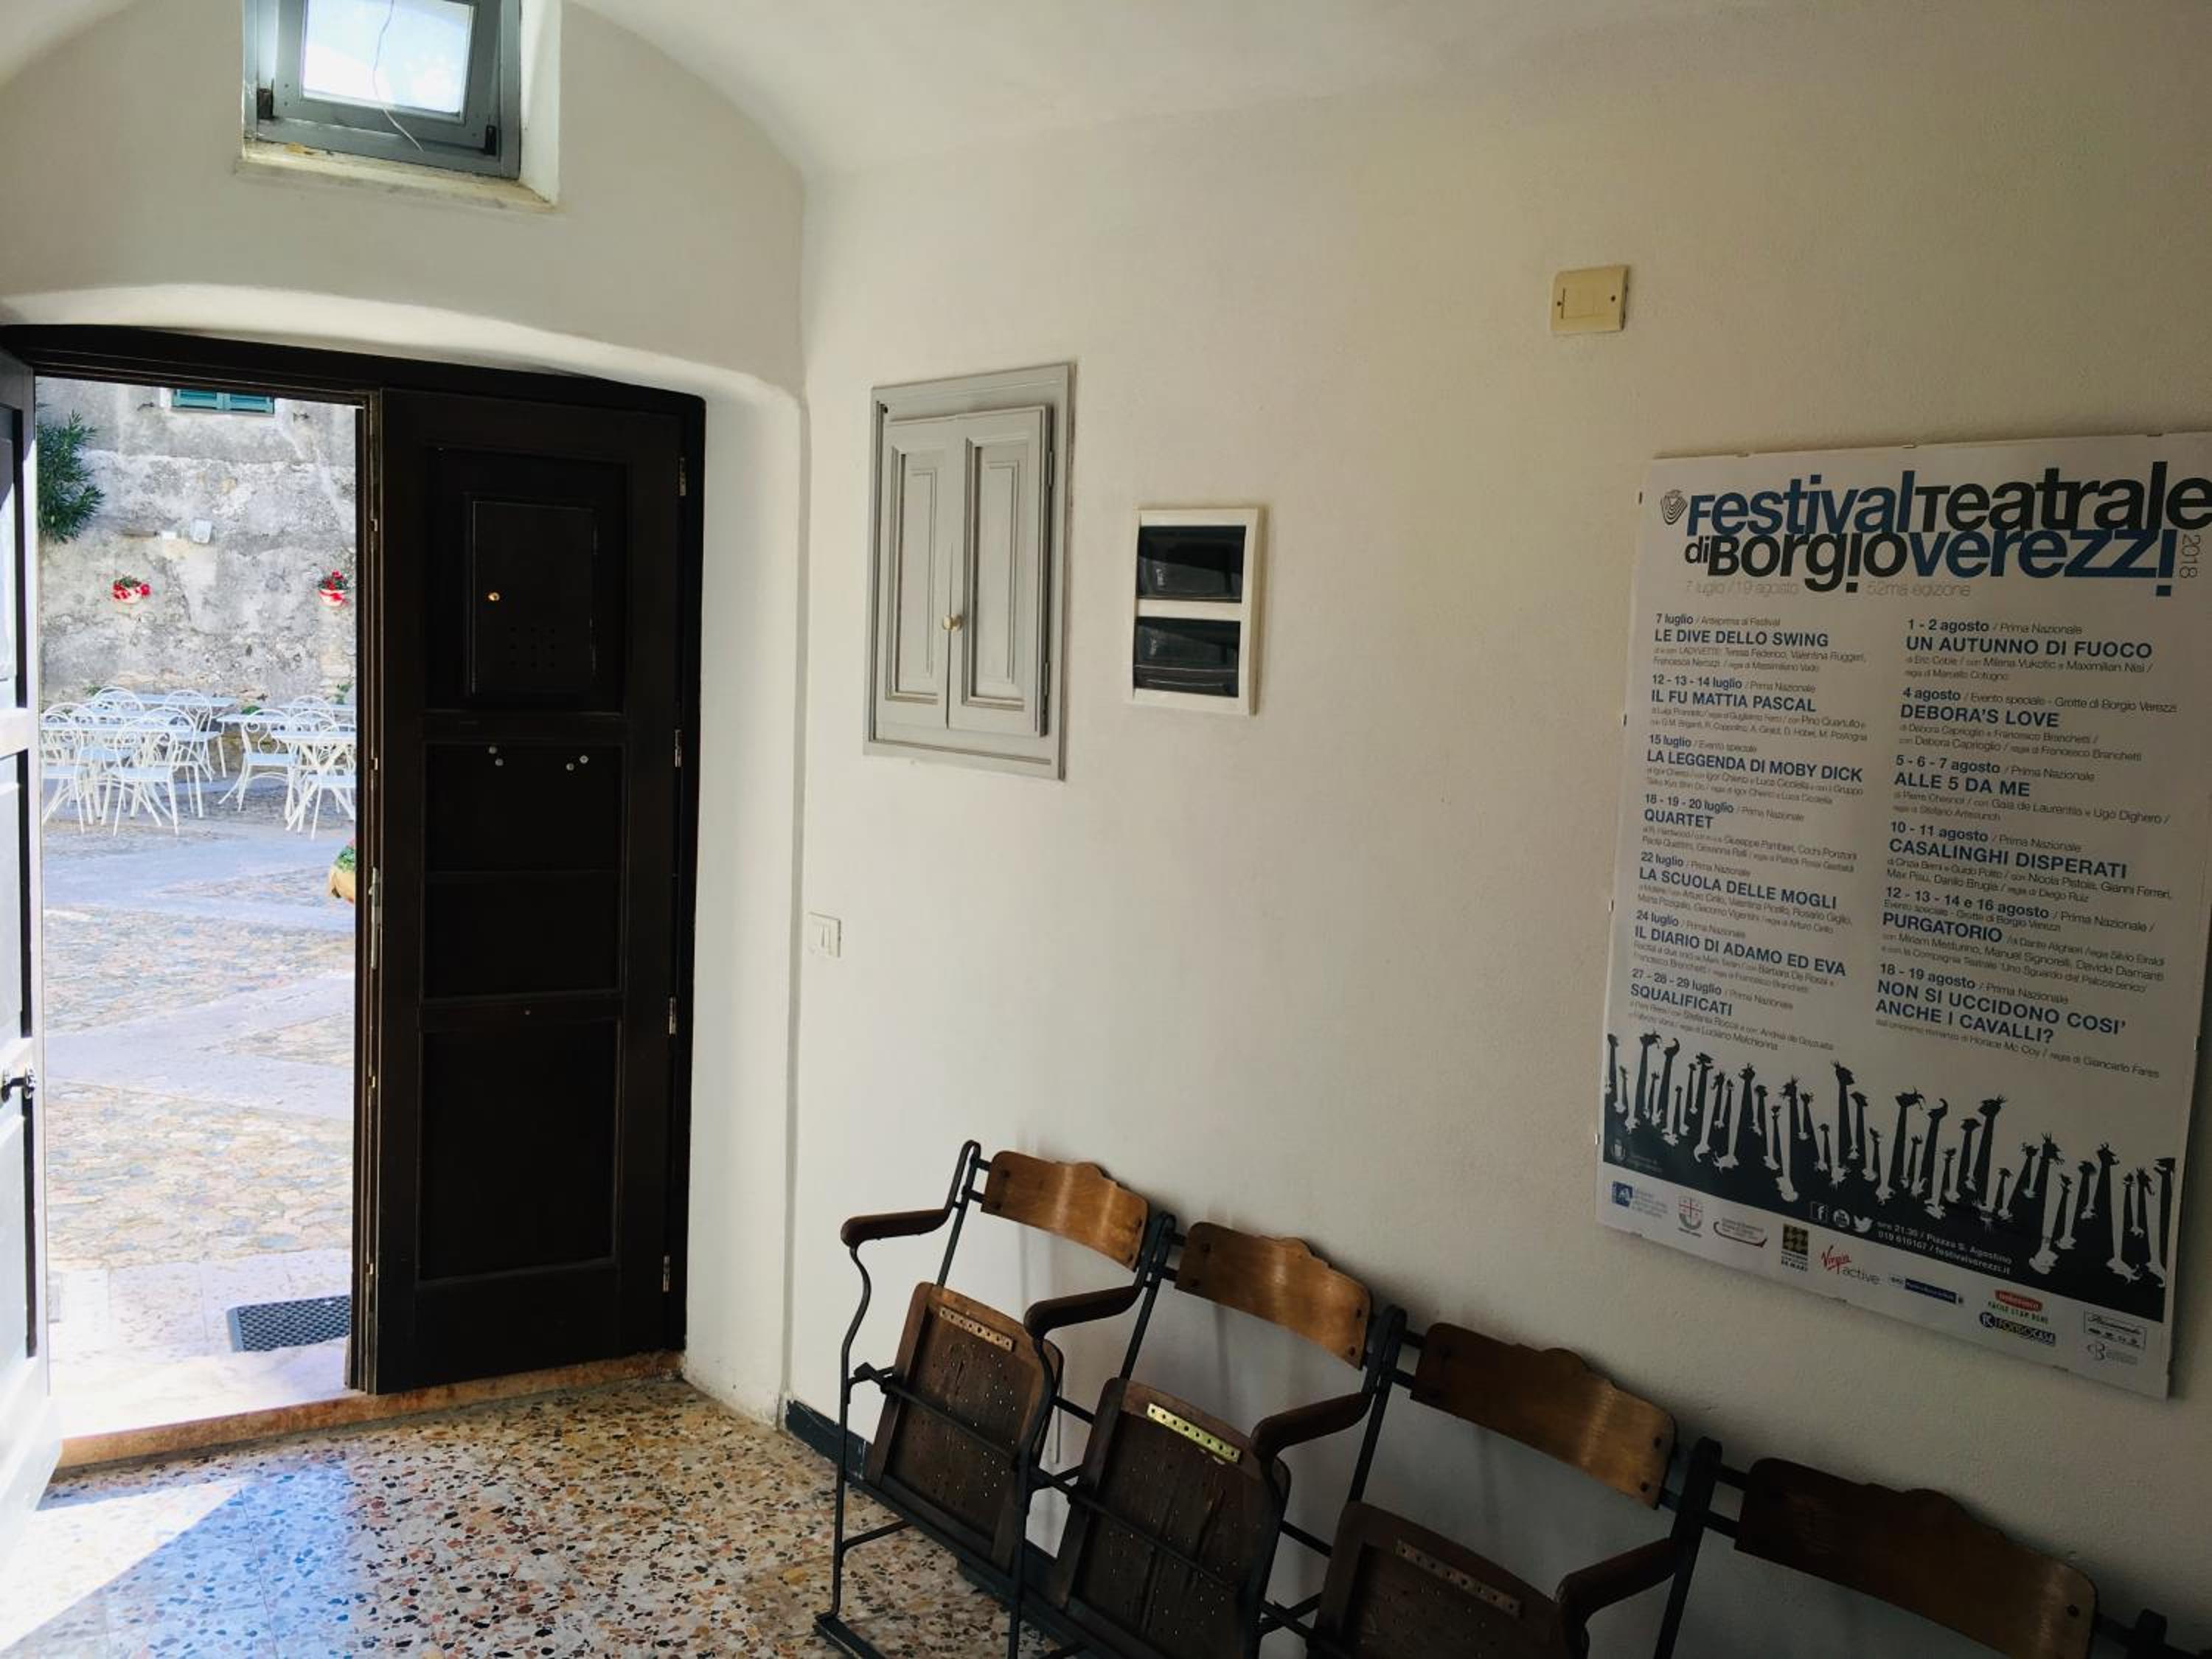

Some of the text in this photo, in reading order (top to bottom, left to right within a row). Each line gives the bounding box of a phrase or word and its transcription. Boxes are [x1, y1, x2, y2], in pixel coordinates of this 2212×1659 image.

[2180, 535, 2200, 578] 2018
[1656, 613, 1662, 622] 7
[1665, 613, 1693, 626] luglio
[1908, 619, 2083, 636] 1 2 agosto Prima Nazionale
[1655, 629, 1829, 647] LE DIVE DELLO SWING
[1906, 637, 2152, 658] UN AUTUNNO DI FUOCO
[1652, 675, 1663, 684] 12
[1674, 675, 1687, 686] 13
[1698, 676, 1711, 686] 14
[1713, 677, 1742, 690] luglio
[1652, 689, 1816, 712] IL FU MATTIA PASCAL
[1903, 688, 1911, 698] 4
[1914, 689, 1960, 701] agosto
[2006, 709, 2059, 728] LOVE
[1649, 734, 1660, 745] 15
[1663, 735, 1691, 748] luglio
[1646, 749, 1863, 782] LA LEGGENDA DI MOBY DICK
[1896, 755, 1904, 765] 5
[1917, 757, 1925, 768] 6
[1939, 758, 1947, 769] 7
[1950, 760, 2000, 775] agosto
[1894, 771, 2030, 797] ALLE 5 DA ME
[1645, 793, 1657, 804] 18
[1668, 796, 1678, 807] 19
[1689, 799, 1702, 809] 20
[1704, 800, 1734, 813] luglio
[1644, 809, 1714, 829] QUARTET
[1891, 821, 1905, 833] 10
[1921, 824, 1934, 836] 11
[1939, 827, 1988, 843] agosto
[1641, 852, 1653, 863] 22
[1655, 854, 1683, 867] luglio
[1889, 838, 2126, 880] CASALINGHI DISPERATI
[1639, 867, 1837, 909] LA SCUOLA DELLE MOGLI
[1888, 887, 1901, 899] 12
[1916, 890, 1930, 902] 13
[1945, 894, 1959, 907] 14
[1964, 899, 1972, 909] e
[1979, 899, 1993, 911] 16
[1997, 902, 2049, 919] agosto
[1636, 909, 1649, 921] 24
[1651, 913, 1678, 927] luglio
[1883, 911, 2003, 944] PURGATORIO
[1635, 925, 1846, 976] IL DIARIO DI ADAMO ED EVA
[1632, 968, 1644, 979] 27
[1655, 972, 1666, 984] 28
[1677, 976, 1689, 988] 29
[1692, 980, 1722, 996] luglio
[1880, 963, 1894, 975] 18
[1910, 967, 1924, 980] 19
[1928, 971, 1975, 990] agosto
[1630, 983, 1732, 1016] SQUALIFICATI
[1877, 979, 1919, 1000] NON
[1925, 986, 1941, 1004] SI
[1949, 990, 2059, 1024] UCCIDONO
[1876, 999, 2053, 1044] ANCHE I CAVALLI?
[1821, 1245, 1852, 1274] Virgin
[1841, 1264, 1881, 1285] active
